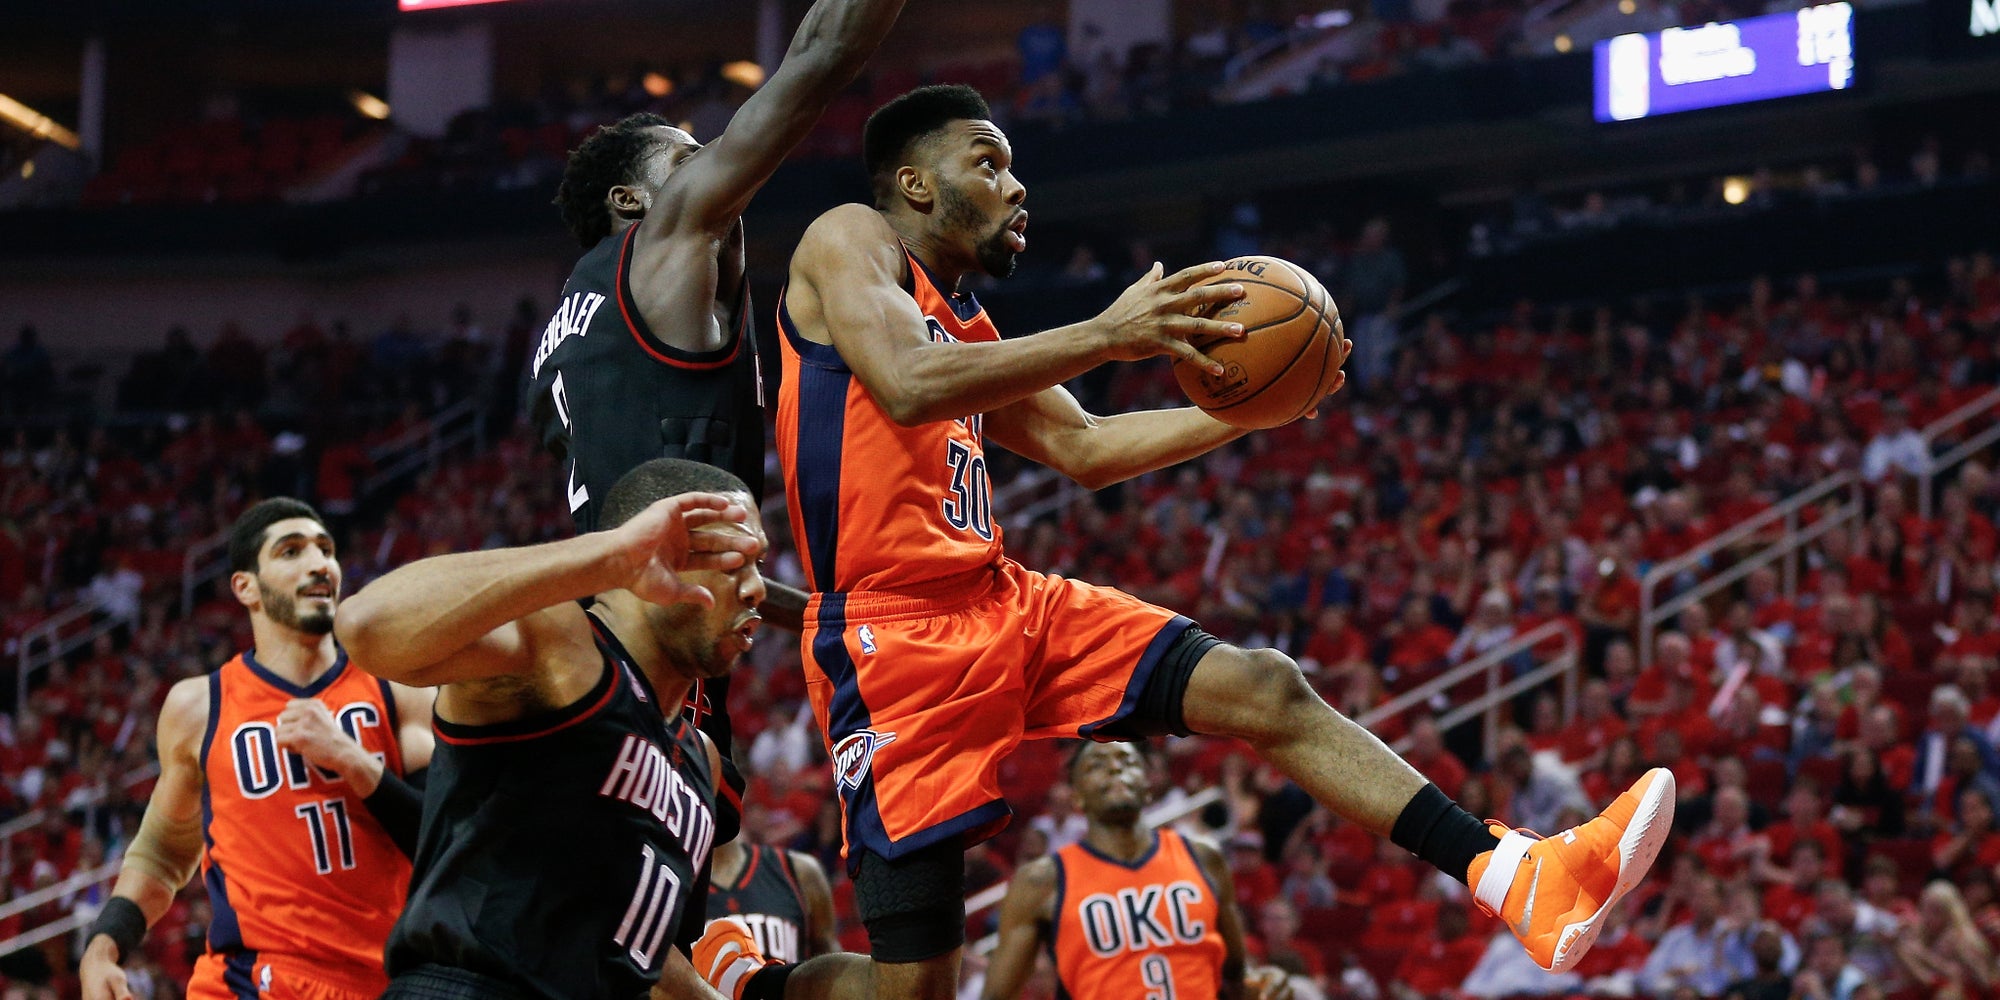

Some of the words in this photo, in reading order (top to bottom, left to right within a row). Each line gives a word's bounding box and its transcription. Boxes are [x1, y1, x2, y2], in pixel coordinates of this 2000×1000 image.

[942, 437, 994, 542] 30
[836, 738, 864, 785] OKC
[295, 797, 356, 875] 11
[613, 843, 680, 970] 10
[1078, 880, 1206, 959] OKC
[1140, 953, 1177, 1000] 9
